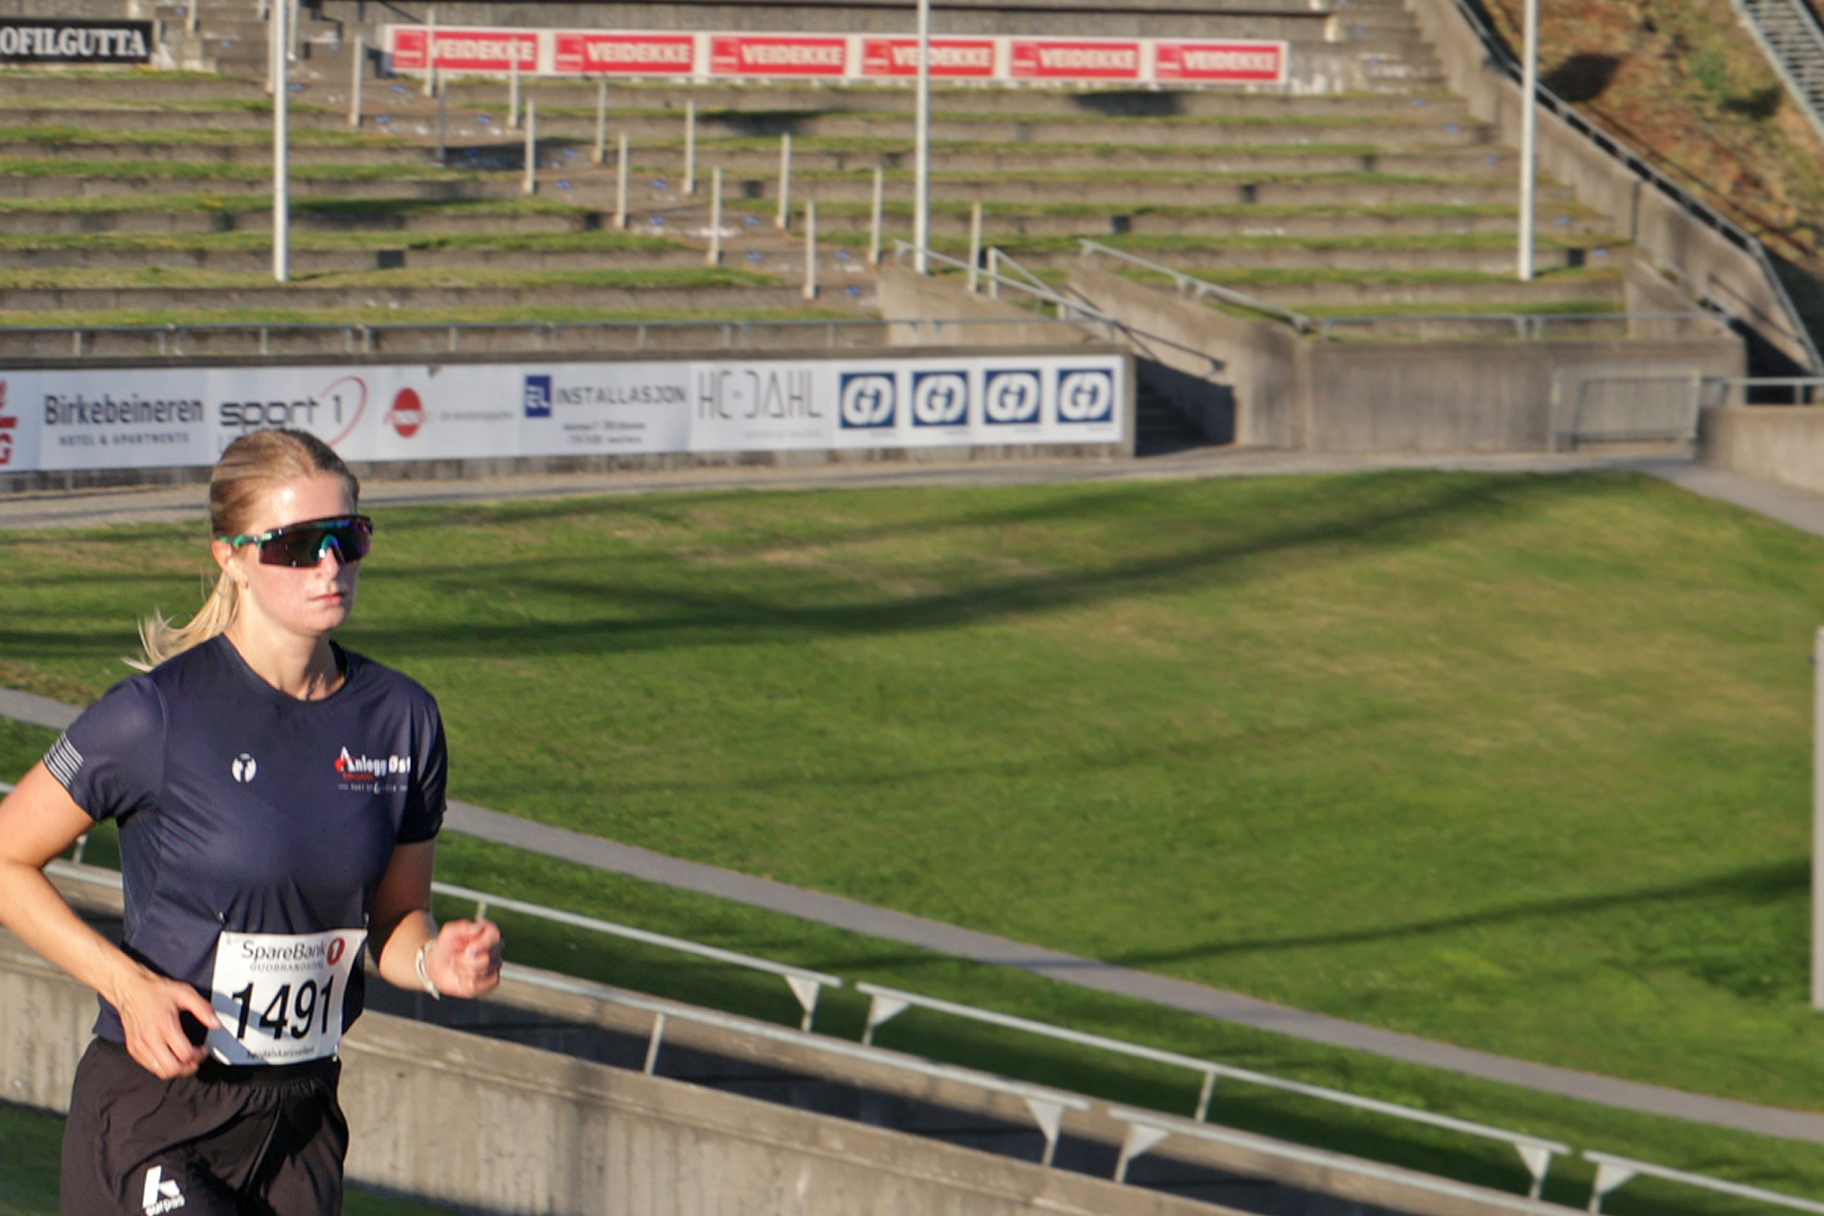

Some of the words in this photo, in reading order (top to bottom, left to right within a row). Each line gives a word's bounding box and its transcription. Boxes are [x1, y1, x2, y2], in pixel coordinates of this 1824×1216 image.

[431, 38, 535, 62] VEIDEKKE
[586, 41, 691, 64] VEIDEKKE
[740, 43, 844, 65] VEIDEKKE
[891, 45, 993, 68] VEDEKKE
[1039, 48, 1136, 69] VEIDEKKE
[1183, 50, 1277, 71] VEIDEKKE
[43, 393, 204, 426] Birkebeineren
[220, 394, 319, 434] sport
[241, 939, 326, 963] SpareBank
[232, 975, 334, 1041] 1491
